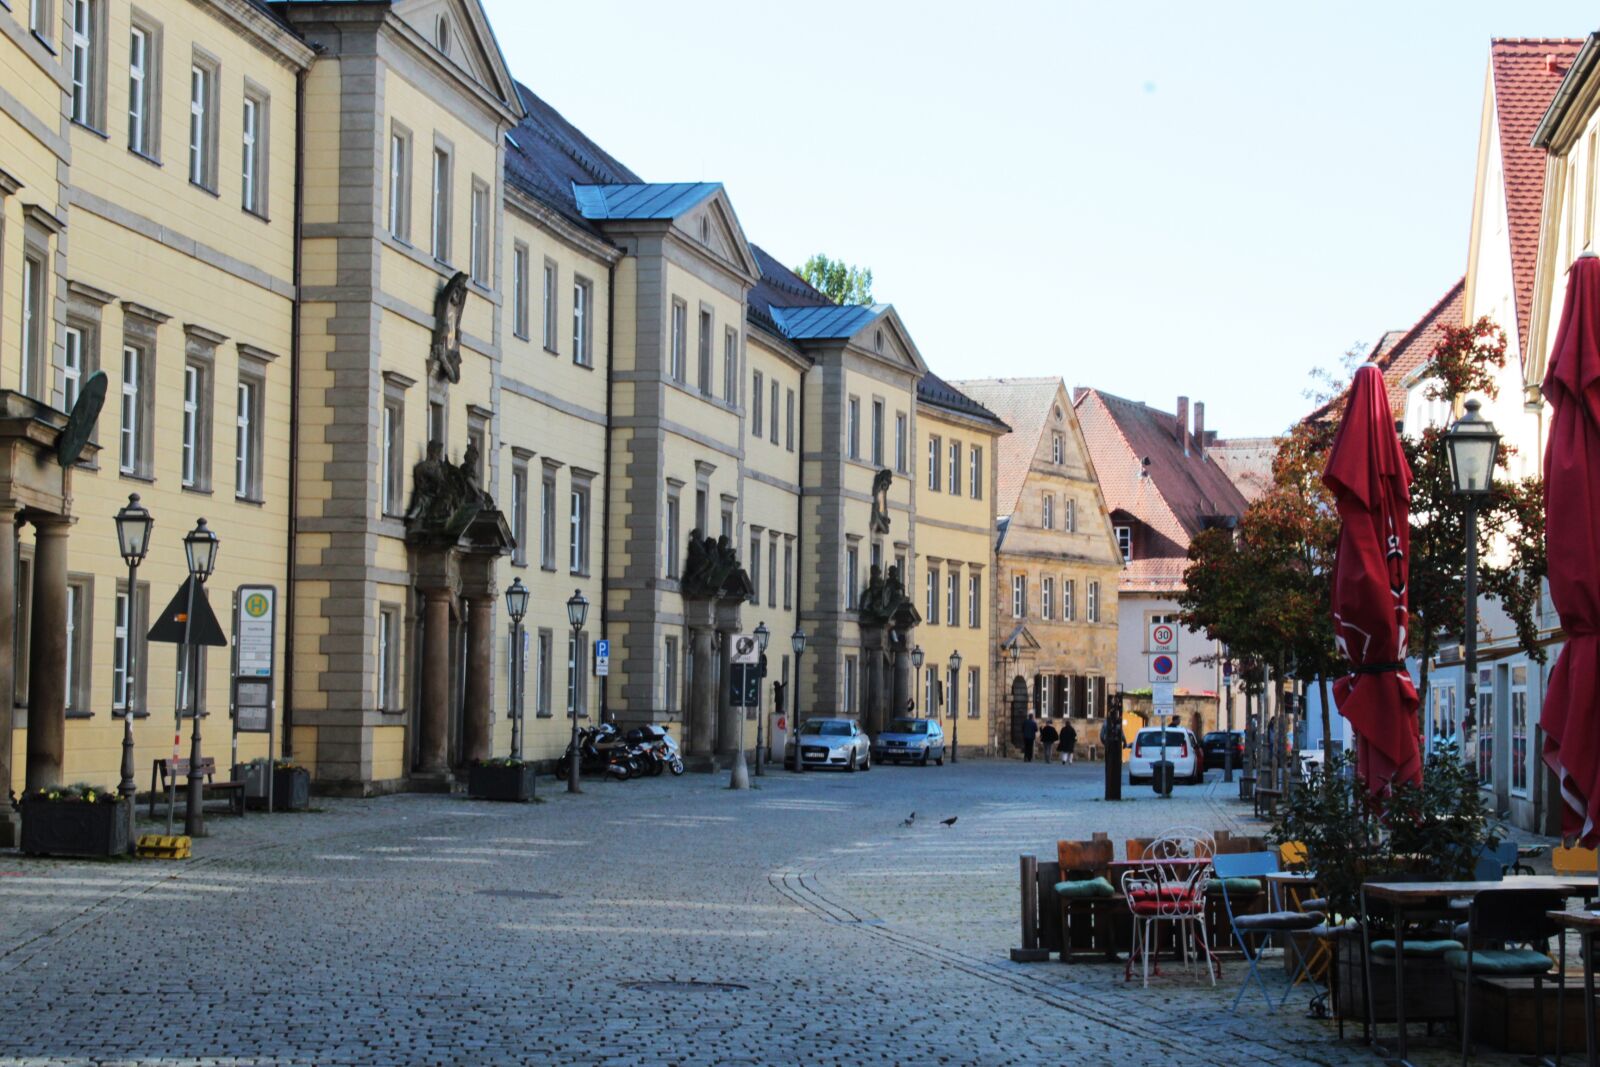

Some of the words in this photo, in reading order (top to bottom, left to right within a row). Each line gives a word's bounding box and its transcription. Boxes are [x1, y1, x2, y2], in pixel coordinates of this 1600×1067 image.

[251, 599, 262, 608] H
[1157, 630, 1169, 640] 30
[599, 642, 607, 656] P
